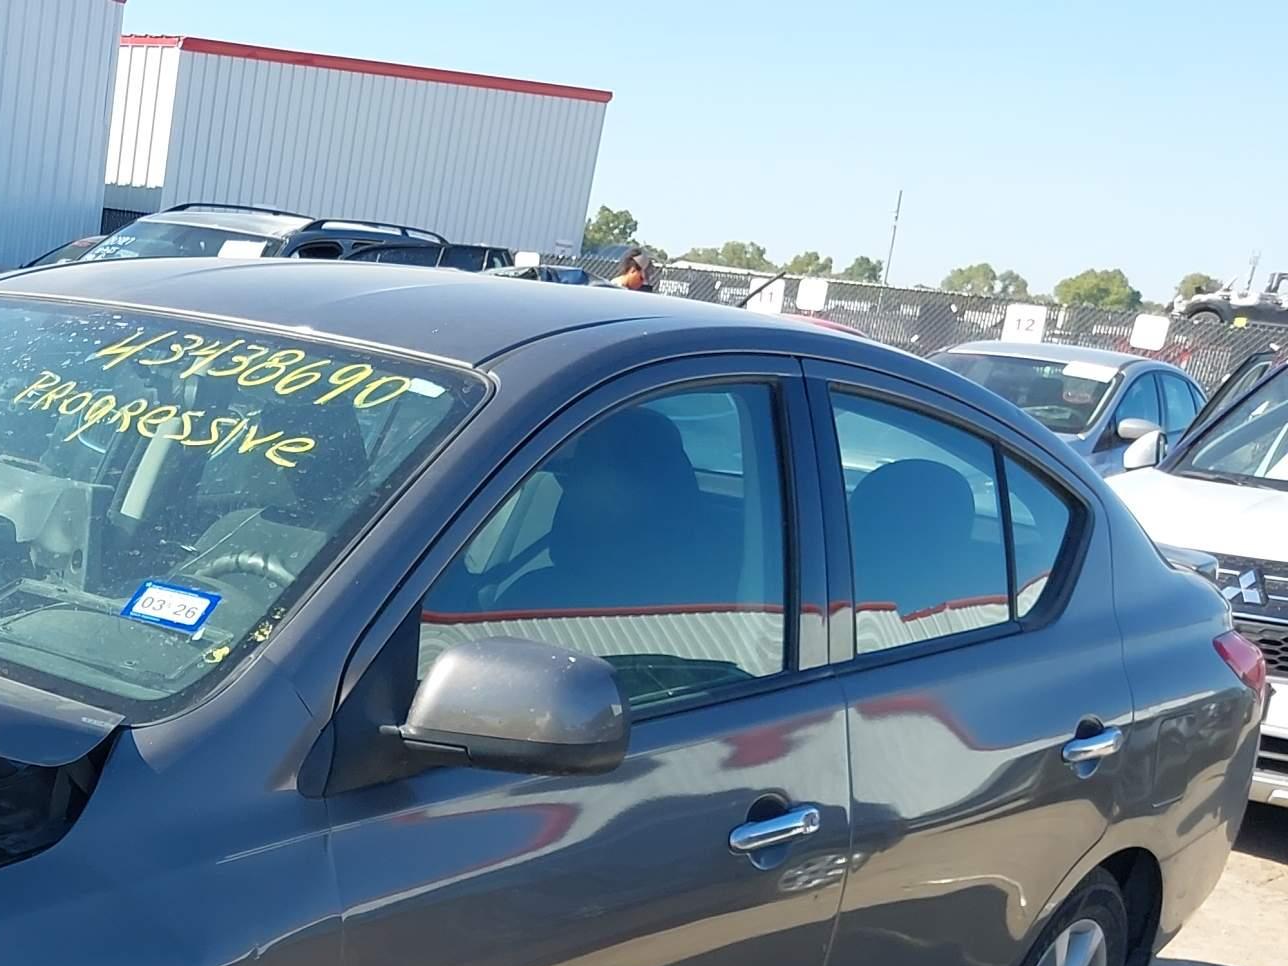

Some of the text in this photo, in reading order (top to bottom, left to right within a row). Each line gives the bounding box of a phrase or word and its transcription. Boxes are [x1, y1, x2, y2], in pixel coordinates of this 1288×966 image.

[1015, 318, 1036, 332] 12
[92, 330, 411, 408] 43438690
[141, 597, 166, 611] 03
[173, 604, 198, 619] 26
